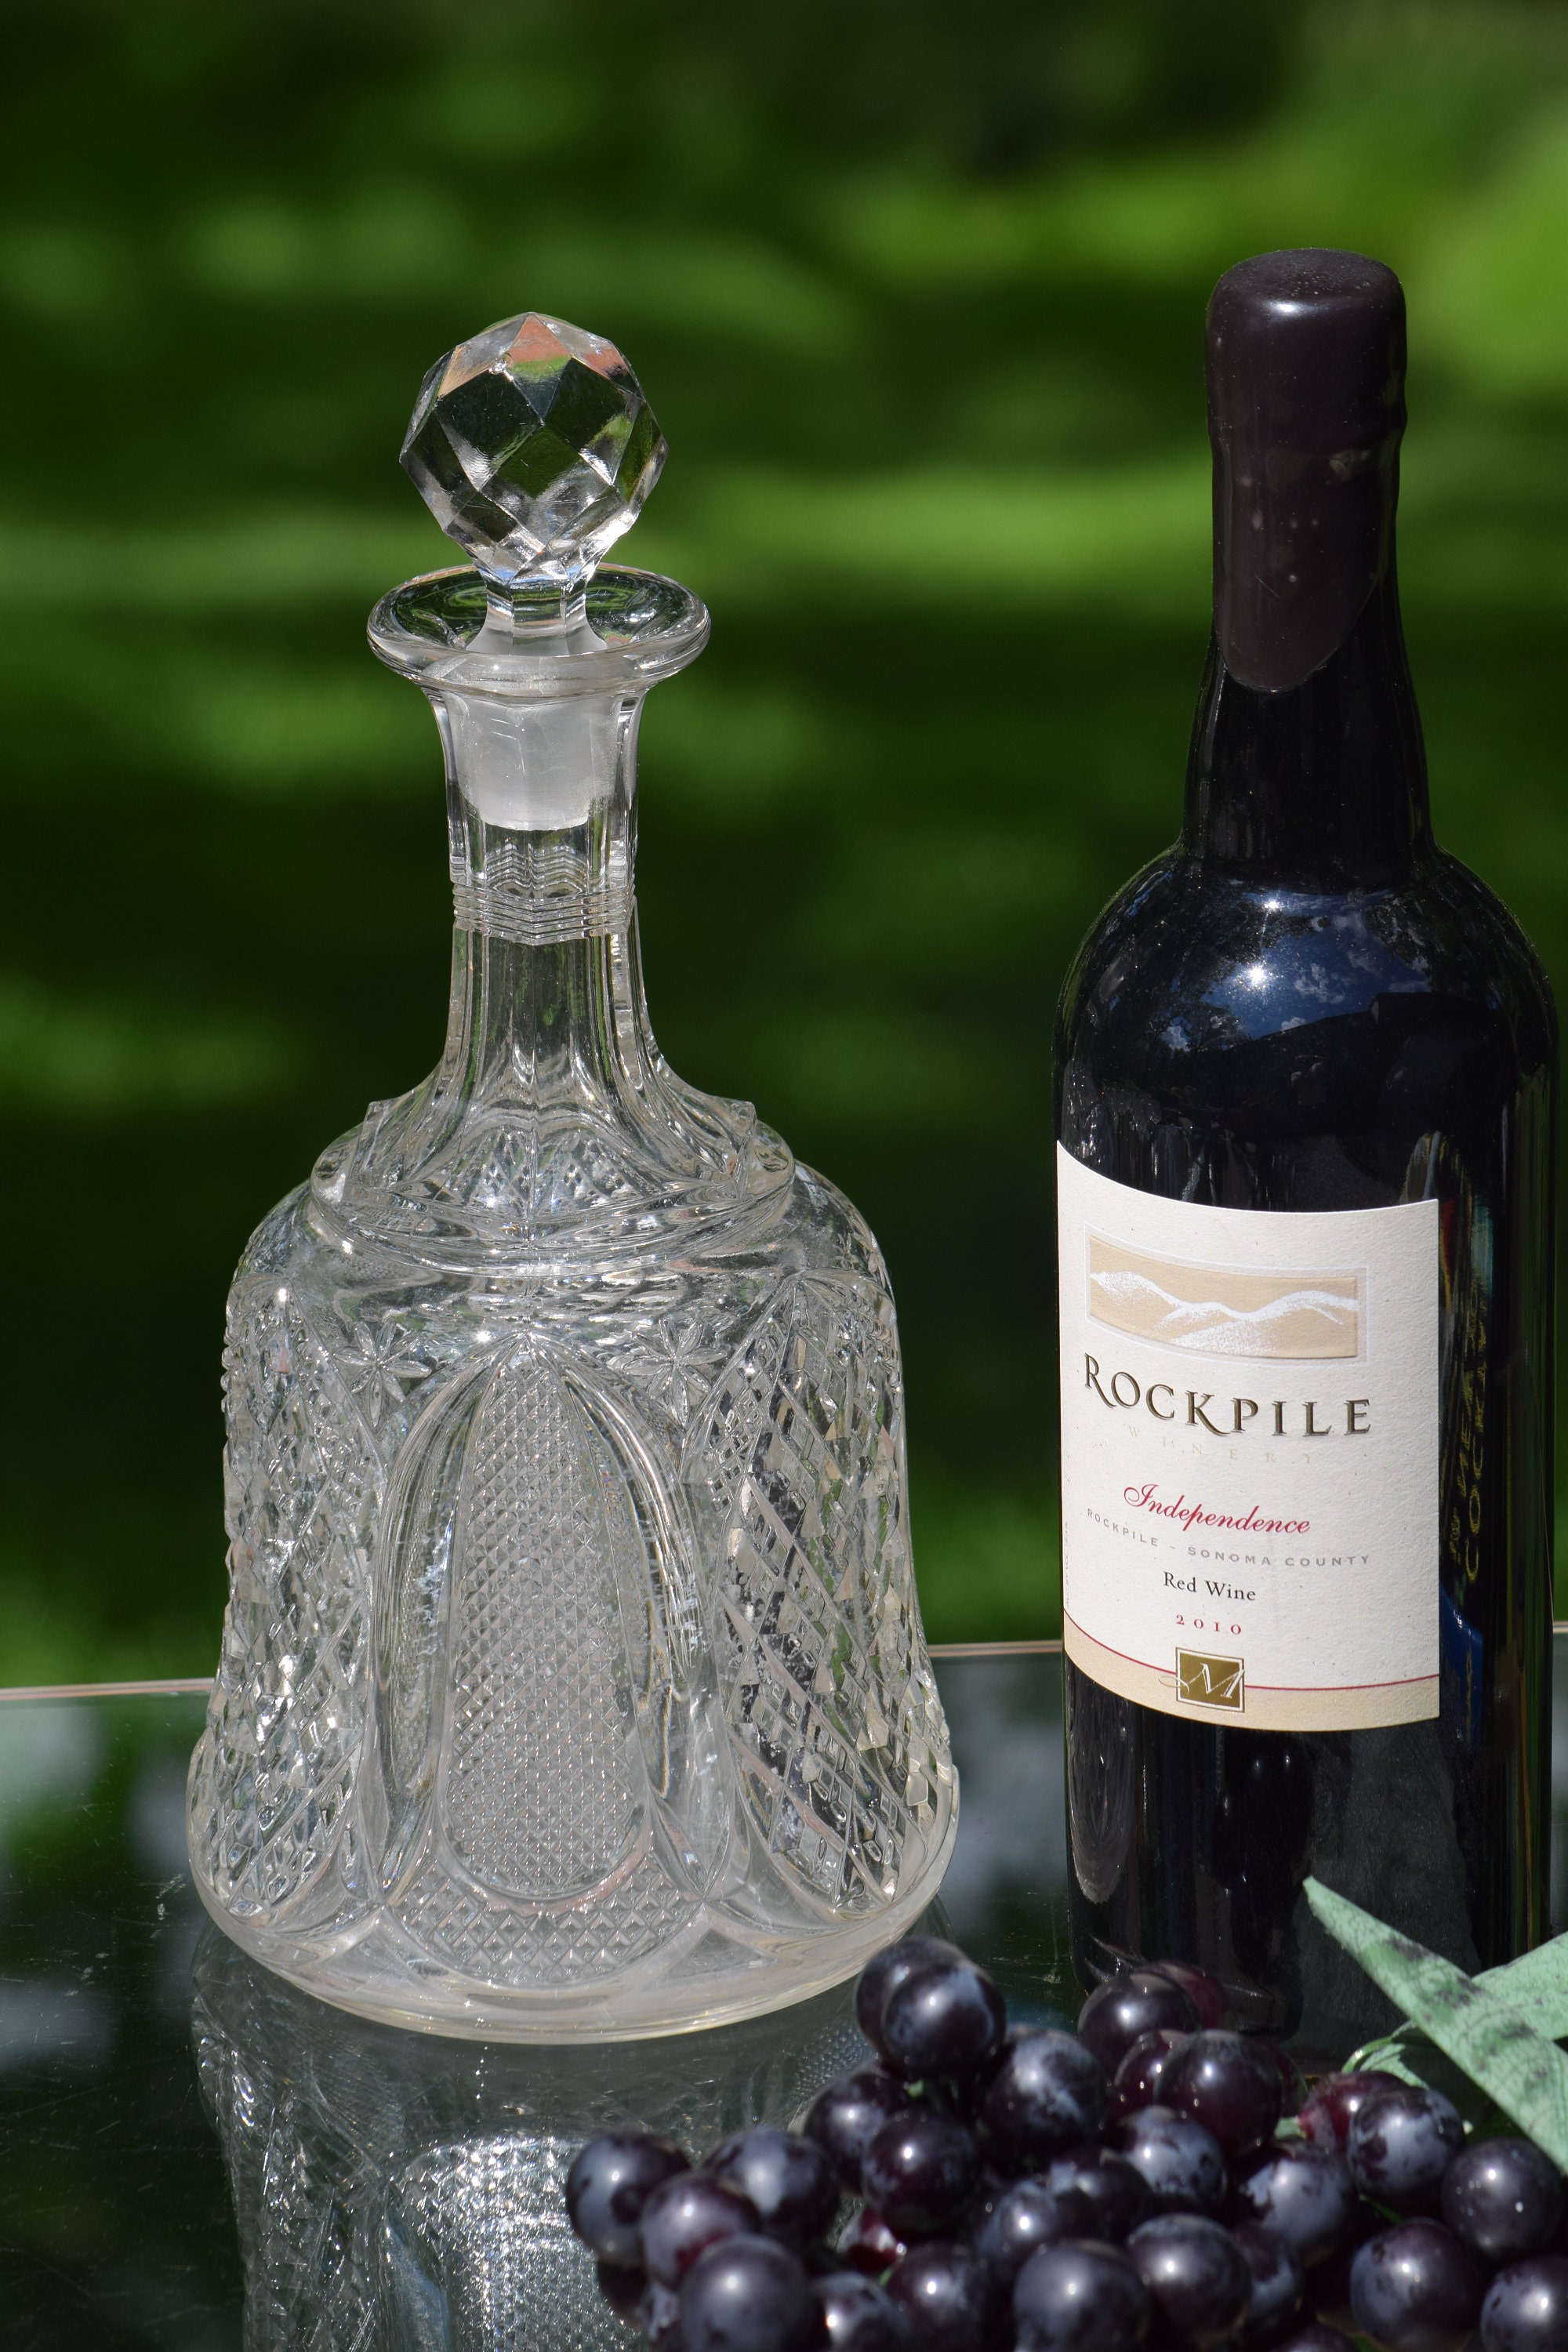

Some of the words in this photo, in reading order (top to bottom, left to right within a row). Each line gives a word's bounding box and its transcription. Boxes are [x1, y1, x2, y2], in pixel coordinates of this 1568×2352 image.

[1085, 1352, 1371, 1436] ROCKPILE
[1129, 1425, 1312, 1464] WINERY
[1123, 1483, 1310, 1534] Independence
[1087, 1508, 1159, 1547] ROCKPILE
[1188, 1546, 1272, 1566] SONOMA
[1285, 1555, 1370, 1566] COUNTY
[1163, 1571, 1196, 1592] Red
[1204, 1580, 1256, 1601] Wine
[1176, 1614, 1242, 1635] 2010
